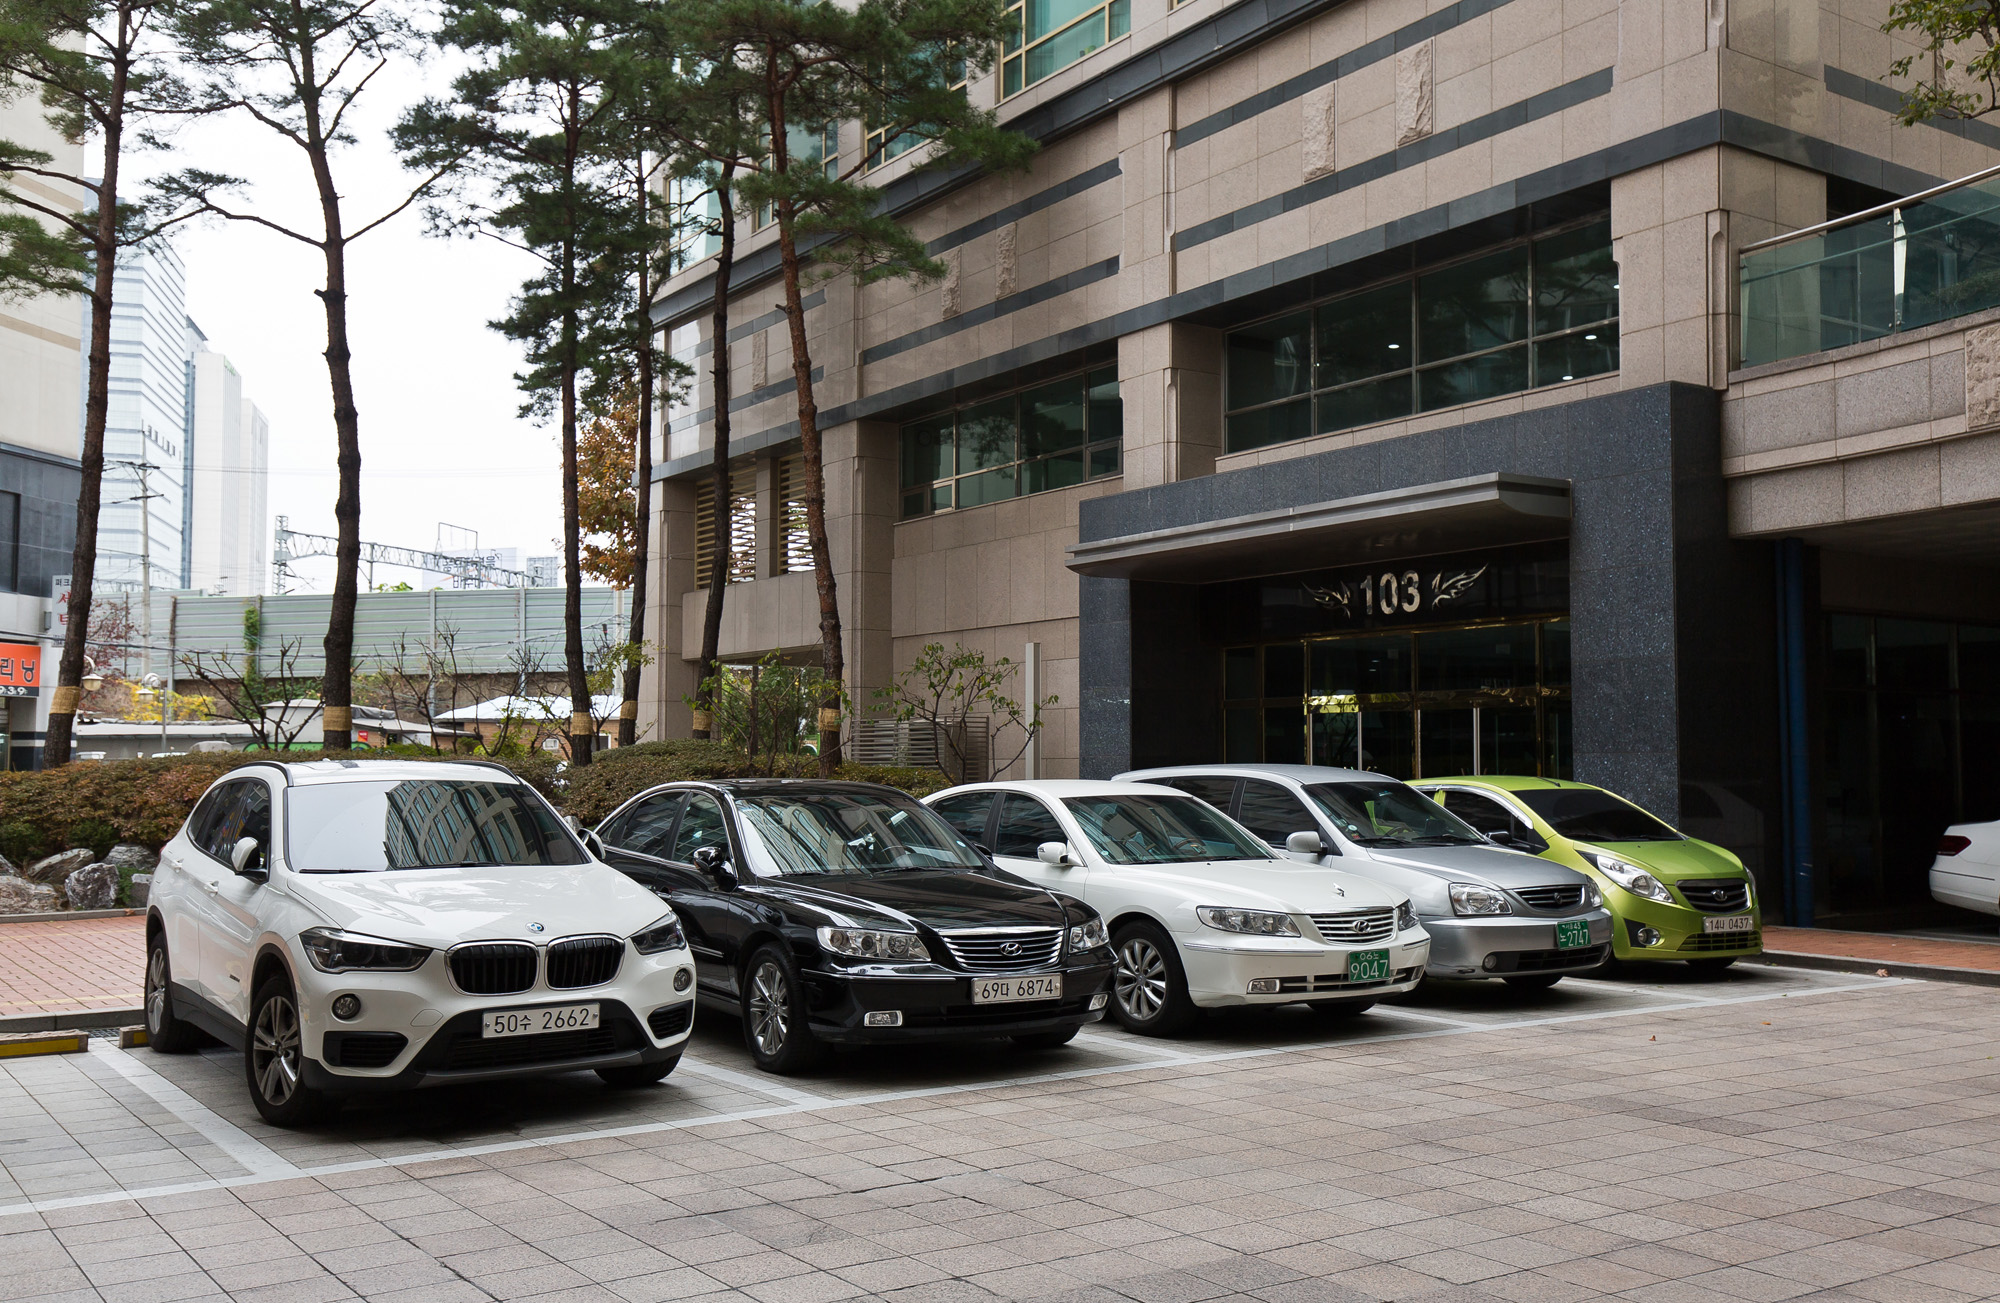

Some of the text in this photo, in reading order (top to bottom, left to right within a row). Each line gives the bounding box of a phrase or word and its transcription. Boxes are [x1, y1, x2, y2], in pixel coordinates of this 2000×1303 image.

[1360, 570, 1420, 615] 103
[1728, 917, 1749, 930] 0437
[1567, 929, 1589, 947] 2747
[1351, 960, 1388, 979] 9047
[981, 979, 1054, 999] 69다 6874
[494, 1008, 589, 1034] 50수 2662
